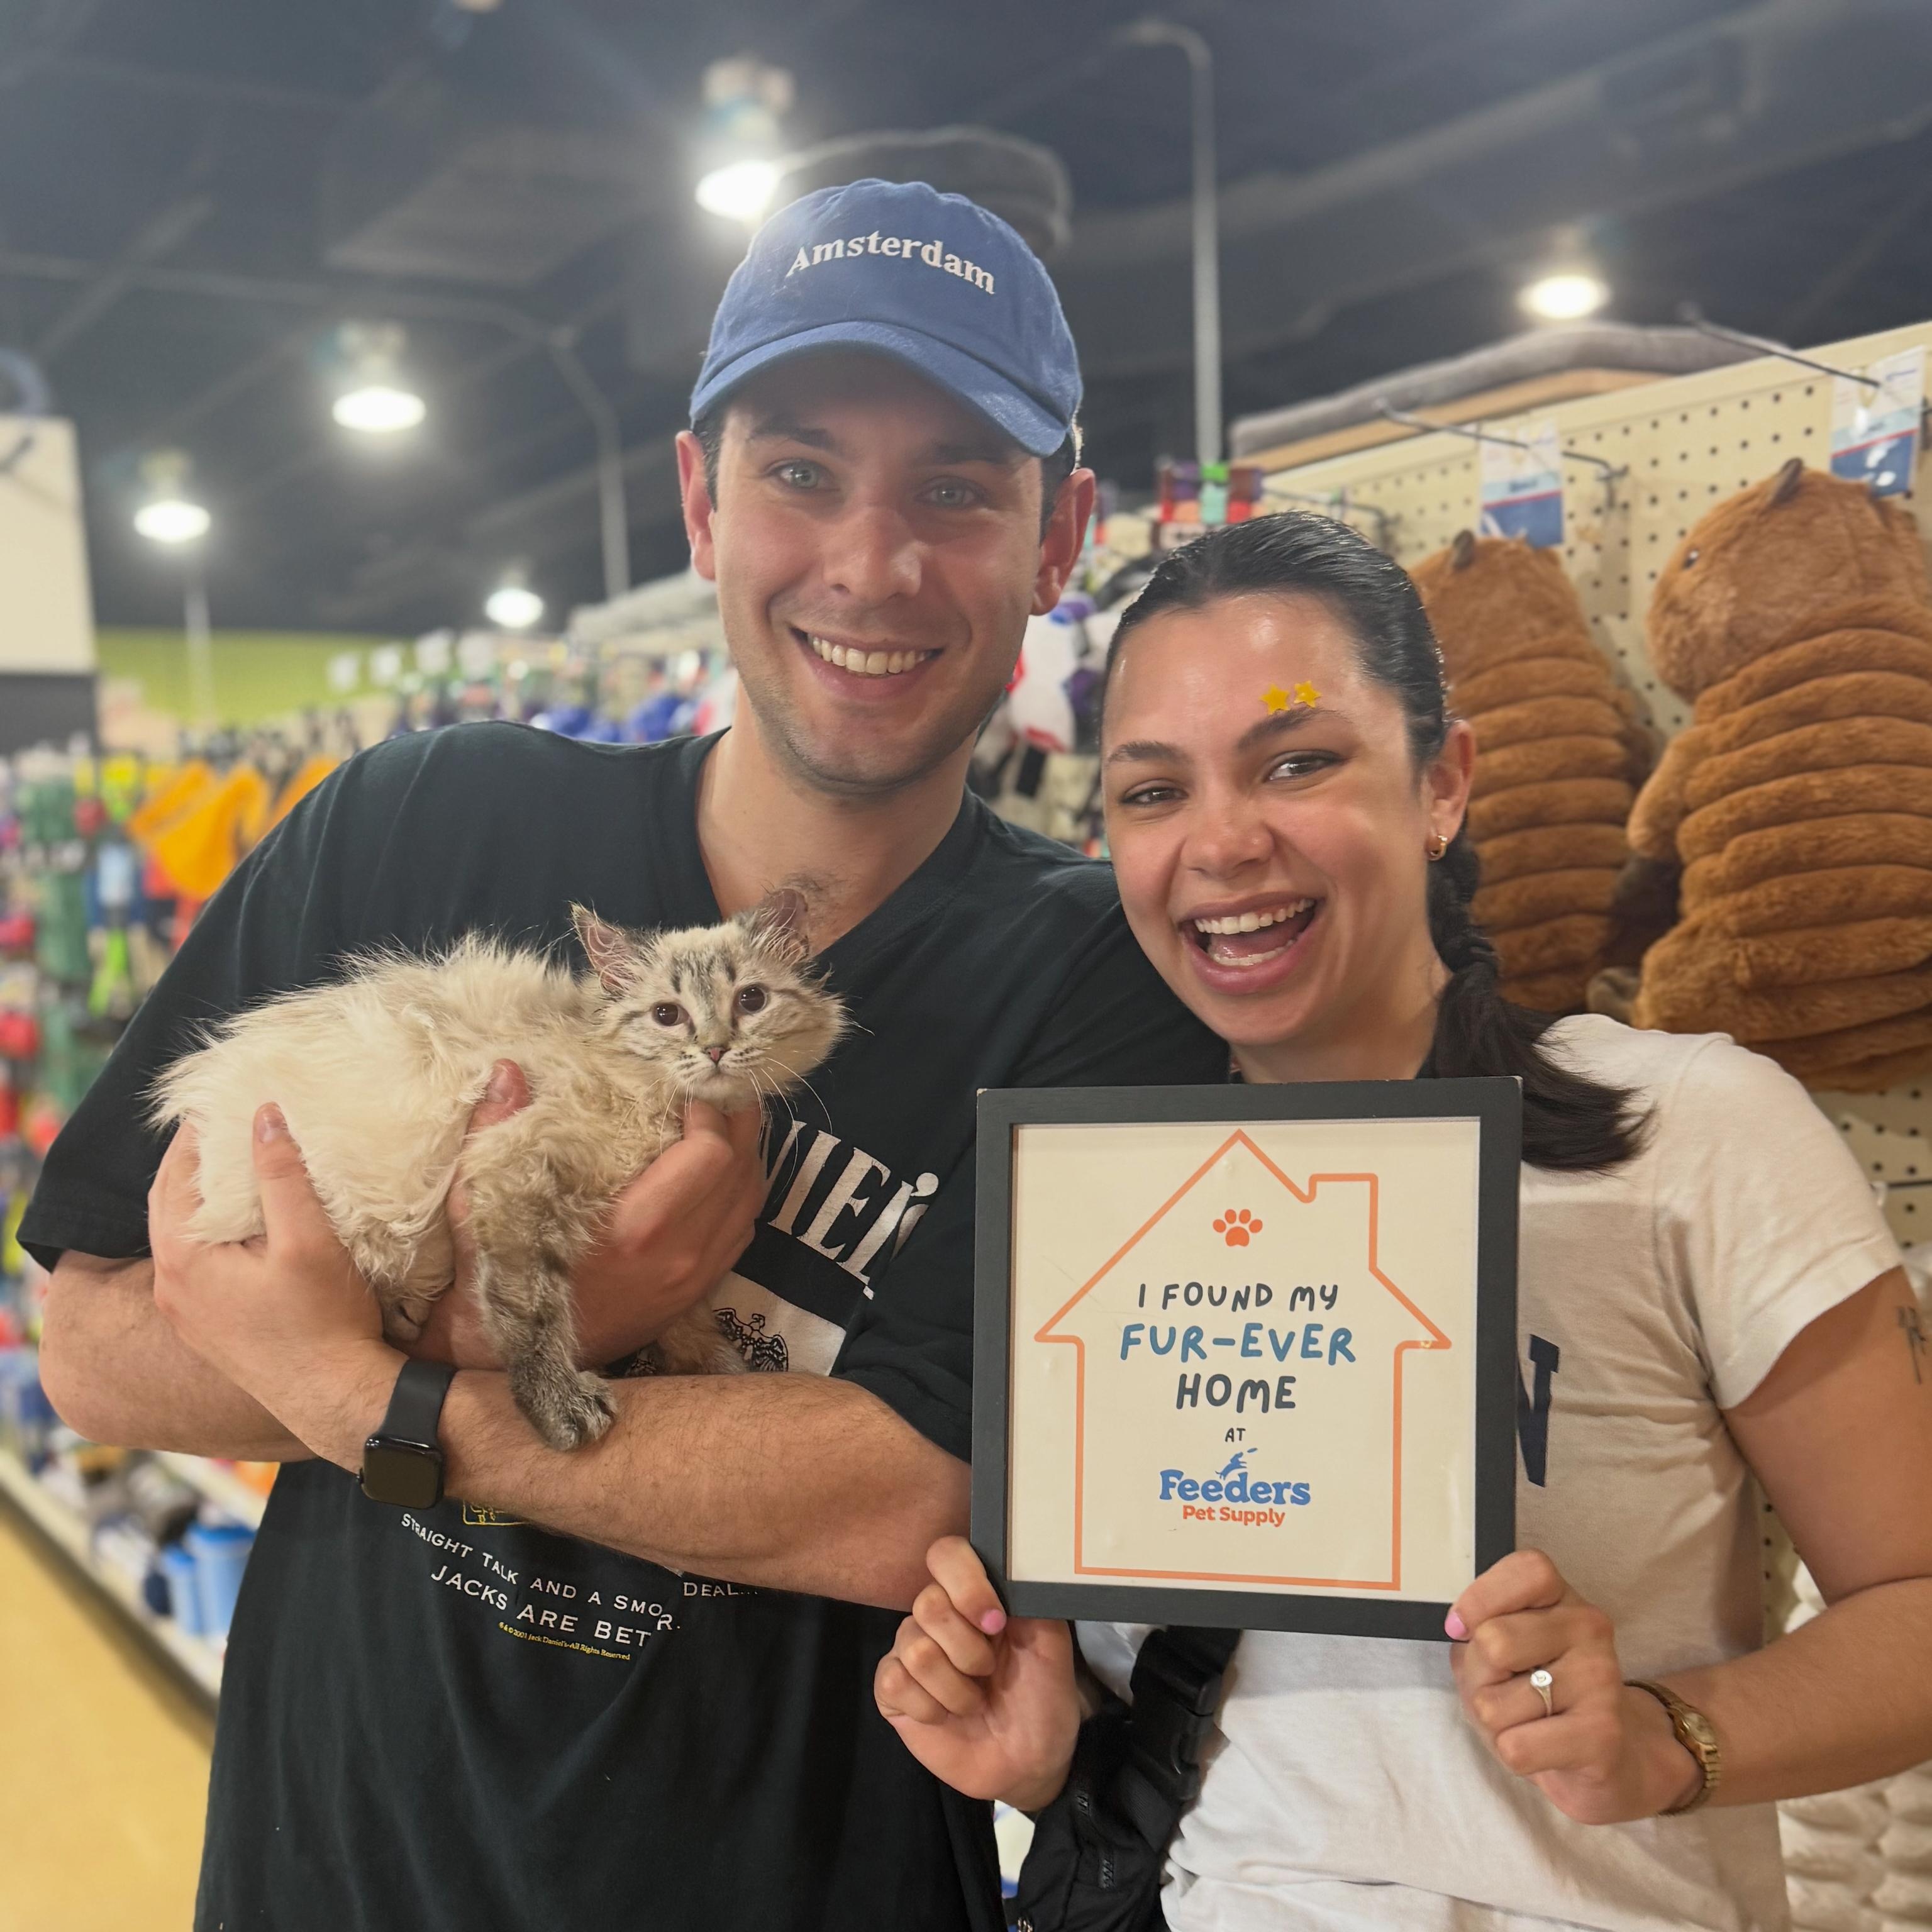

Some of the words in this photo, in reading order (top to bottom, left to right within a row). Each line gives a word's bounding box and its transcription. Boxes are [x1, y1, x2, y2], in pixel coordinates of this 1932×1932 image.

[785, 230, 996, 295] Amsterdam
[1138, 1283, 1146, 1308] I
[1162, 1281, 1273, 1313] FOUND
[1289, 1284, 1338, 1312] MY
[1119, 1323, 1357, 1366] FUR-EVER
[1175, 1373, 1296, 1414] HOME
[1224, 1428, 1246, 1442] AT
[1159, 1469, 1311, 1506] Feeders
[1182, 1505, 1216, 1521] Pet
[1219, 1507, 1286, 1528] Supply
[401, 1513, 473, 1558] STRAIGHT
[482, 1552, 519, 1585] TALK
[530, 1578, 577, 1599] AND
[587, 1592, 602, 1605] A
[431, 1565, 508, 1611] JACKS
[516, 1604, 579, 1633] ARE
